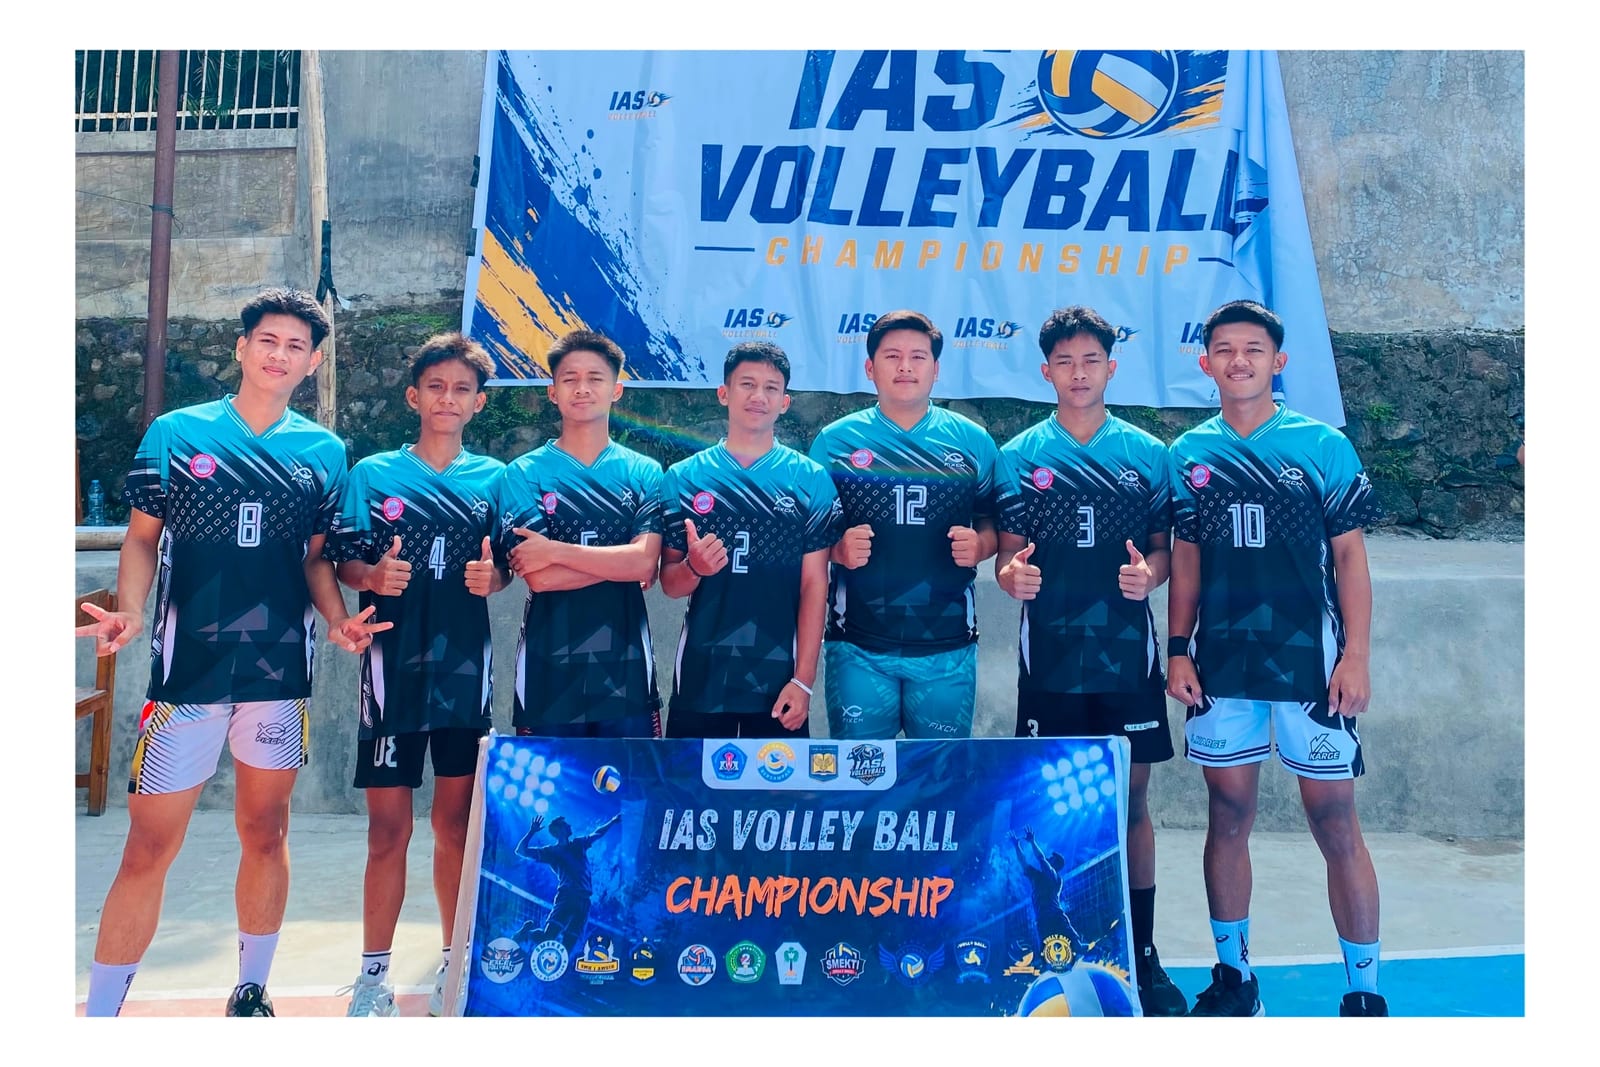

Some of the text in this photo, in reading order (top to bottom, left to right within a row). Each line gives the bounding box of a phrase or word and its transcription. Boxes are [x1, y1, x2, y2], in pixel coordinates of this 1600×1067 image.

[609, 90, 646, 111] IAS
[789, 50, 1005, 131] IAS
[765, 237, 1190, 276] CHAMPIONSHIP
[723, 308, 765, 329] IAS
[837, 313, 877, 334] IAS
[954, 317, 995, 338] IAS
[1180, 322, 1203, 344] IA
[1277, 478, 1303, 487] FIXCH
[892, 484, 927, 525] 12
[237, 502, 263, 547] 8
[1077, 506, 1095, 547] 3
[1227, 503, 1266, 548] 10
[428, 536, 447, 580] 4
[731, 531, 750, 573] 2
[928, 721, 958, 734] FIXCH
[855, 759, 882, 770] IAS
[1308, 750, 1341, 761] KARGE
[658, 808, 959, 852] IAS VOLLEY BALL
[665, 874, 954, 920] CHAMPIONSHIP
[741, 952, 751, 965] 2
[826, 958, 860, 970] SMEKTI
